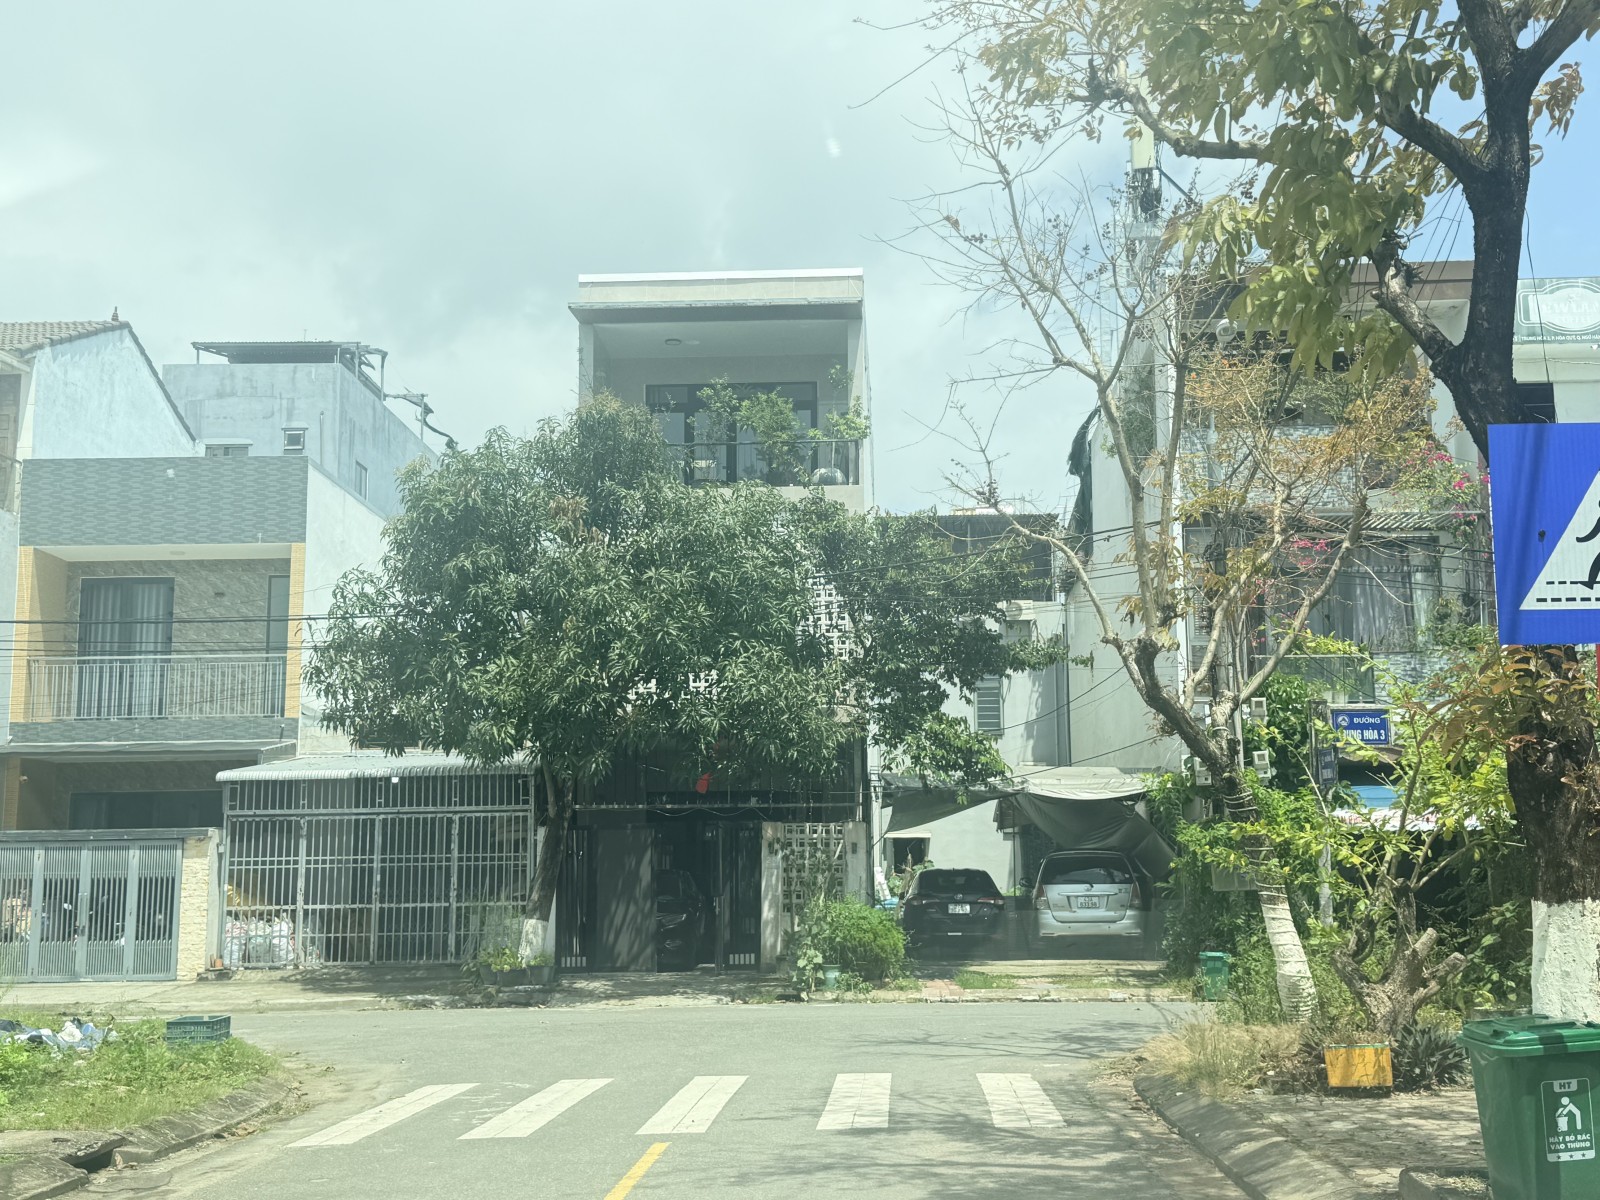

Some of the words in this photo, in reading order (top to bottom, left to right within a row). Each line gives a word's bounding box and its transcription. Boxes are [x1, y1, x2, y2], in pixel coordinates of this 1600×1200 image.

[1353, 716, 1380, 724] ĐƯỜNG
[1363, 726, 1379, 740] HÒA
[1380, 729, 1385, 740] 3
[1559, 1082, 1571, 1090] HT
[1577, 1132, 1590, 1140] RÁC
[1567, 1140, 1590, 1148] THÙNG
